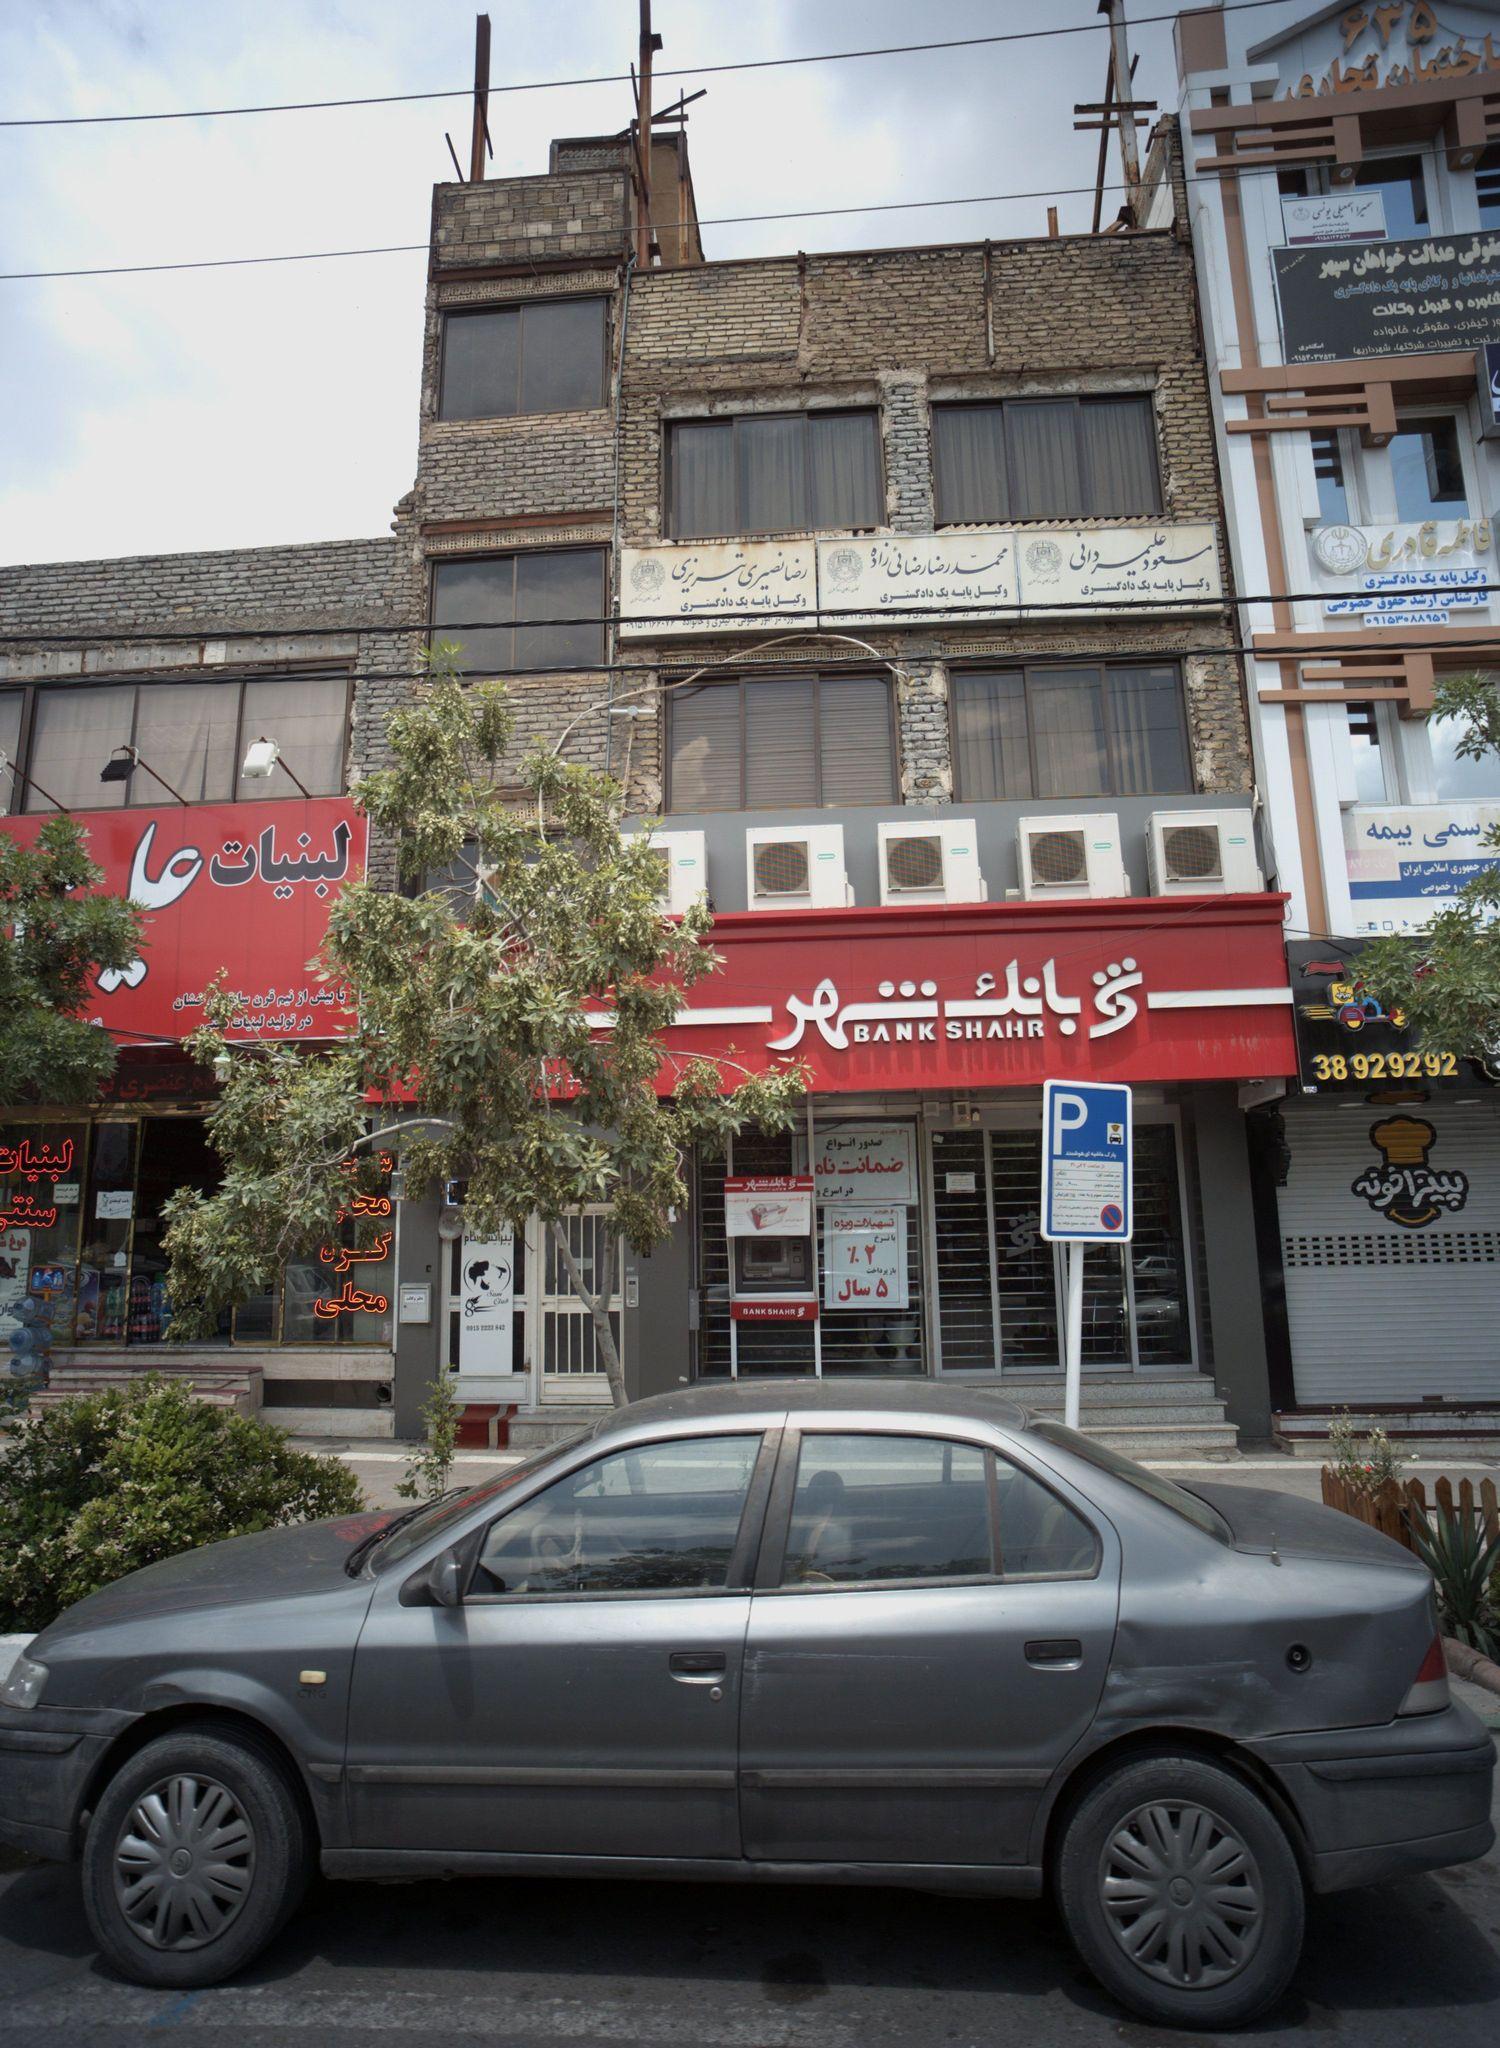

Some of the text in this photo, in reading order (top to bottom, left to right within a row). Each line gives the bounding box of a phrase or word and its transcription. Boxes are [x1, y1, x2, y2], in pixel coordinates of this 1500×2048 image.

[1319, 258, 1351, 279] سپهر
[1353, 246, 1406, 275] خواهان
[1334, 281, 1380, 299] دادگستری
[1372, 302, 1415, 317] وکالت
[1418, 298, 1451, 315] قبول
[1373, 326, 1409, 336] خانواده
[1366, 517, 1491, 571] فاطمه قادری
[1142, 543, 1213, 571] مسعود
[738, 552, 785, 591] نصیری
[784, 558, 807, 582] رضا
[1365, 569, 1487, 590] وکیل پایه یک دادگستری
[880, 584, 1008, 604] وکیل پایه یک دادگستری
[1080, 577, 1210, 596] وکیل پایه یک دادگستری
[680, 593, 807, 612] وکیل پایه یک دادگستری
[1327, 598, 1373, 613] خصوصی
[1377, 596, 1407, 610] حقوق
[1410, 593, 1437, 608] ارشد
[1366, 612, 1447, 625] ۰۹۱۵۳۰۸۸۹۵۹
[1366, 822, 1412, 846] بیمه
[209, 820, 353, 899] لبنیات
[1423, 862, 1449, 876] اسلامی
[1450, 863, 1480, 875] جمهوری
[1403, 864, 1422, 877] ایران
[1421, 880, 1451, 894] خصوصی
[252, 989, 276, 1009] قرن
[277, 989, 294, 1007] نیم
[296, 989, 308, 1007] از
[309, 988, 334, 1006] بیش
[335, 988, 347, 1004] با
[766, 957, 1083, 1051] بانک شهر
[231, 1013, 265, 1032] لبنیات
[266, 1013, 296, 1032] تولید
[298, 1014, 313, 1030] در
[853, 1017, 1048, 1043] BANK SHAHR
[825, 1136, 883, 1151] صدور انواع
[838, 1154, 904, 1175] ضمانت
[822, 1186, 843, 1197] اسرع
[845, 1186, 854, 1197] در
[1356, 1166, 1464, 1208] پیتزا خونه
[0, 1196, 57, 1234] سنت
[834, 1217, 895, 1231] تسهیلات ویژه
[838, 1276, 889, 1301] ۵ سال
[314, 1281, 388, 1320] محلی
